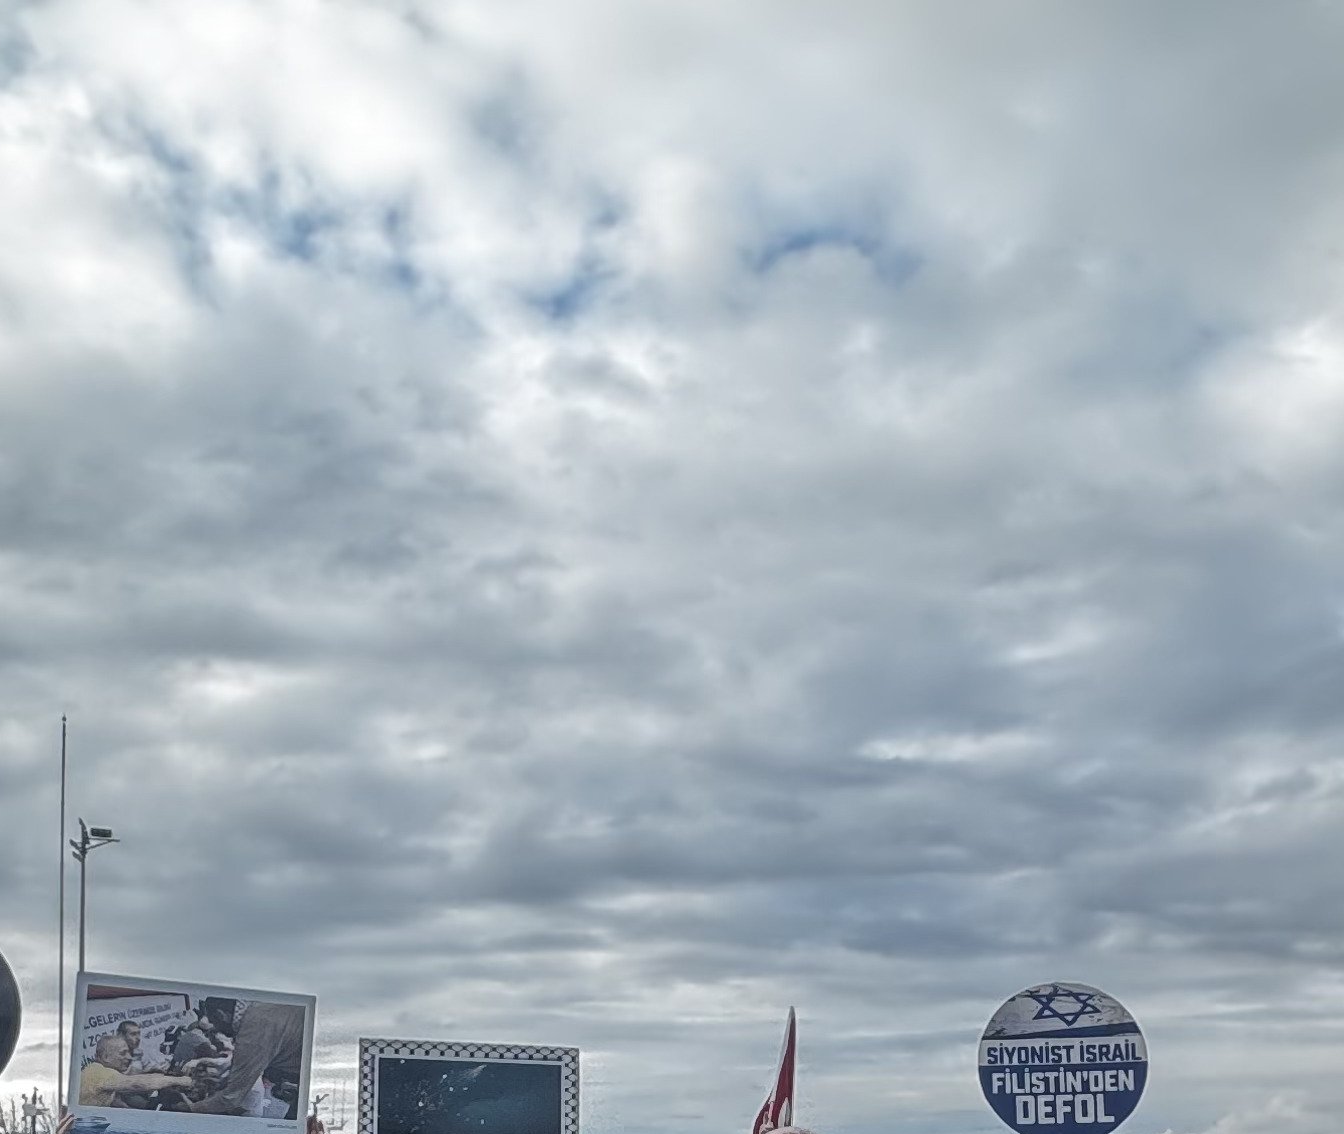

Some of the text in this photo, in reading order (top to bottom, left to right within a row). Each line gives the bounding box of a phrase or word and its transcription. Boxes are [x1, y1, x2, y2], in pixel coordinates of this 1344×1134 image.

[986, 1038, 1143, 1065] SİYONİST İSRAİL
[991, 1067, 1135, 1095] FİLİSTİN'DEN
[1015, 1094, 1116, 1126] DEFOL
